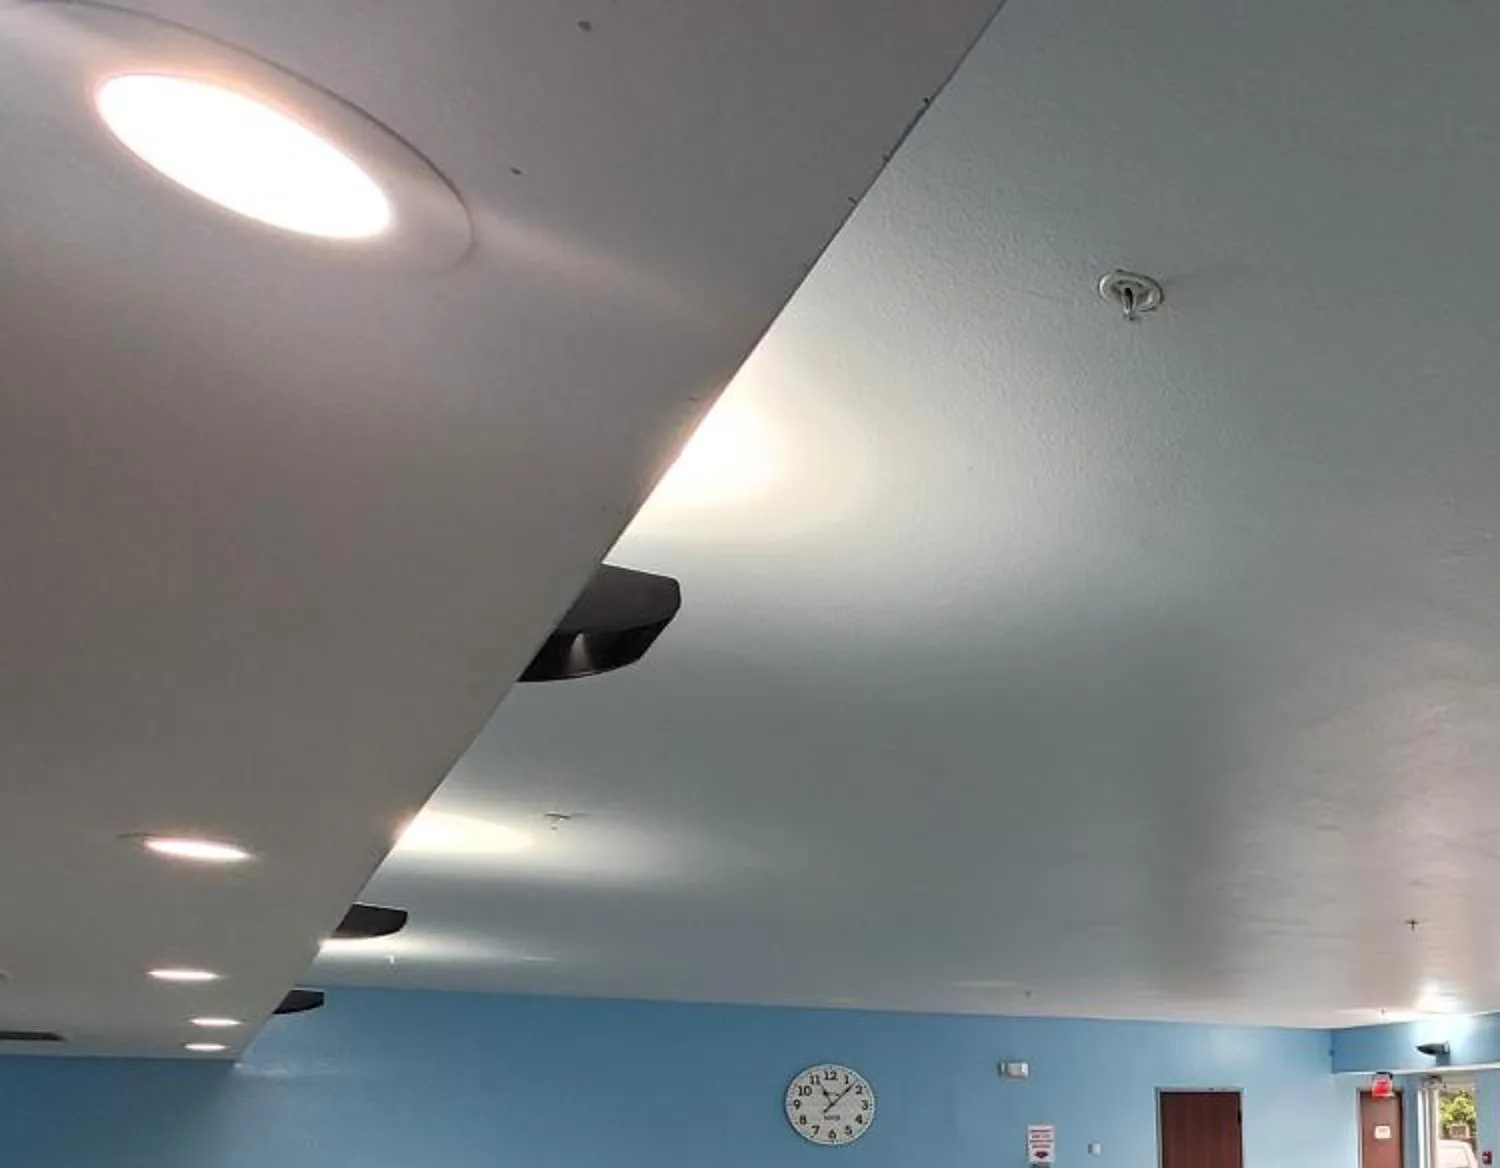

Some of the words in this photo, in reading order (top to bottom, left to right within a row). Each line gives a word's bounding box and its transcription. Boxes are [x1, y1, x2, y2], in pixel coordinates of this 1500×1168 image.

[809, 1073, 821, 1084] 11
[823, 1070, 838, 1081] 12
[843, 1073, 850, 1085] 1
[797, 1085, 813, 1097] 10
[855, 1084, 864, 1095] 2
[793, 1099, 802, 1110] 9
[861, 1099, 870, 1111] 3
[799, 1114, 808, 1125] 8
[854, 1113, 863, 1125] 4
[811, 1125, 820, 1135] 7
[828, 1128, 837, 1139] 6
[844, 1124, 853, 1135] 5
